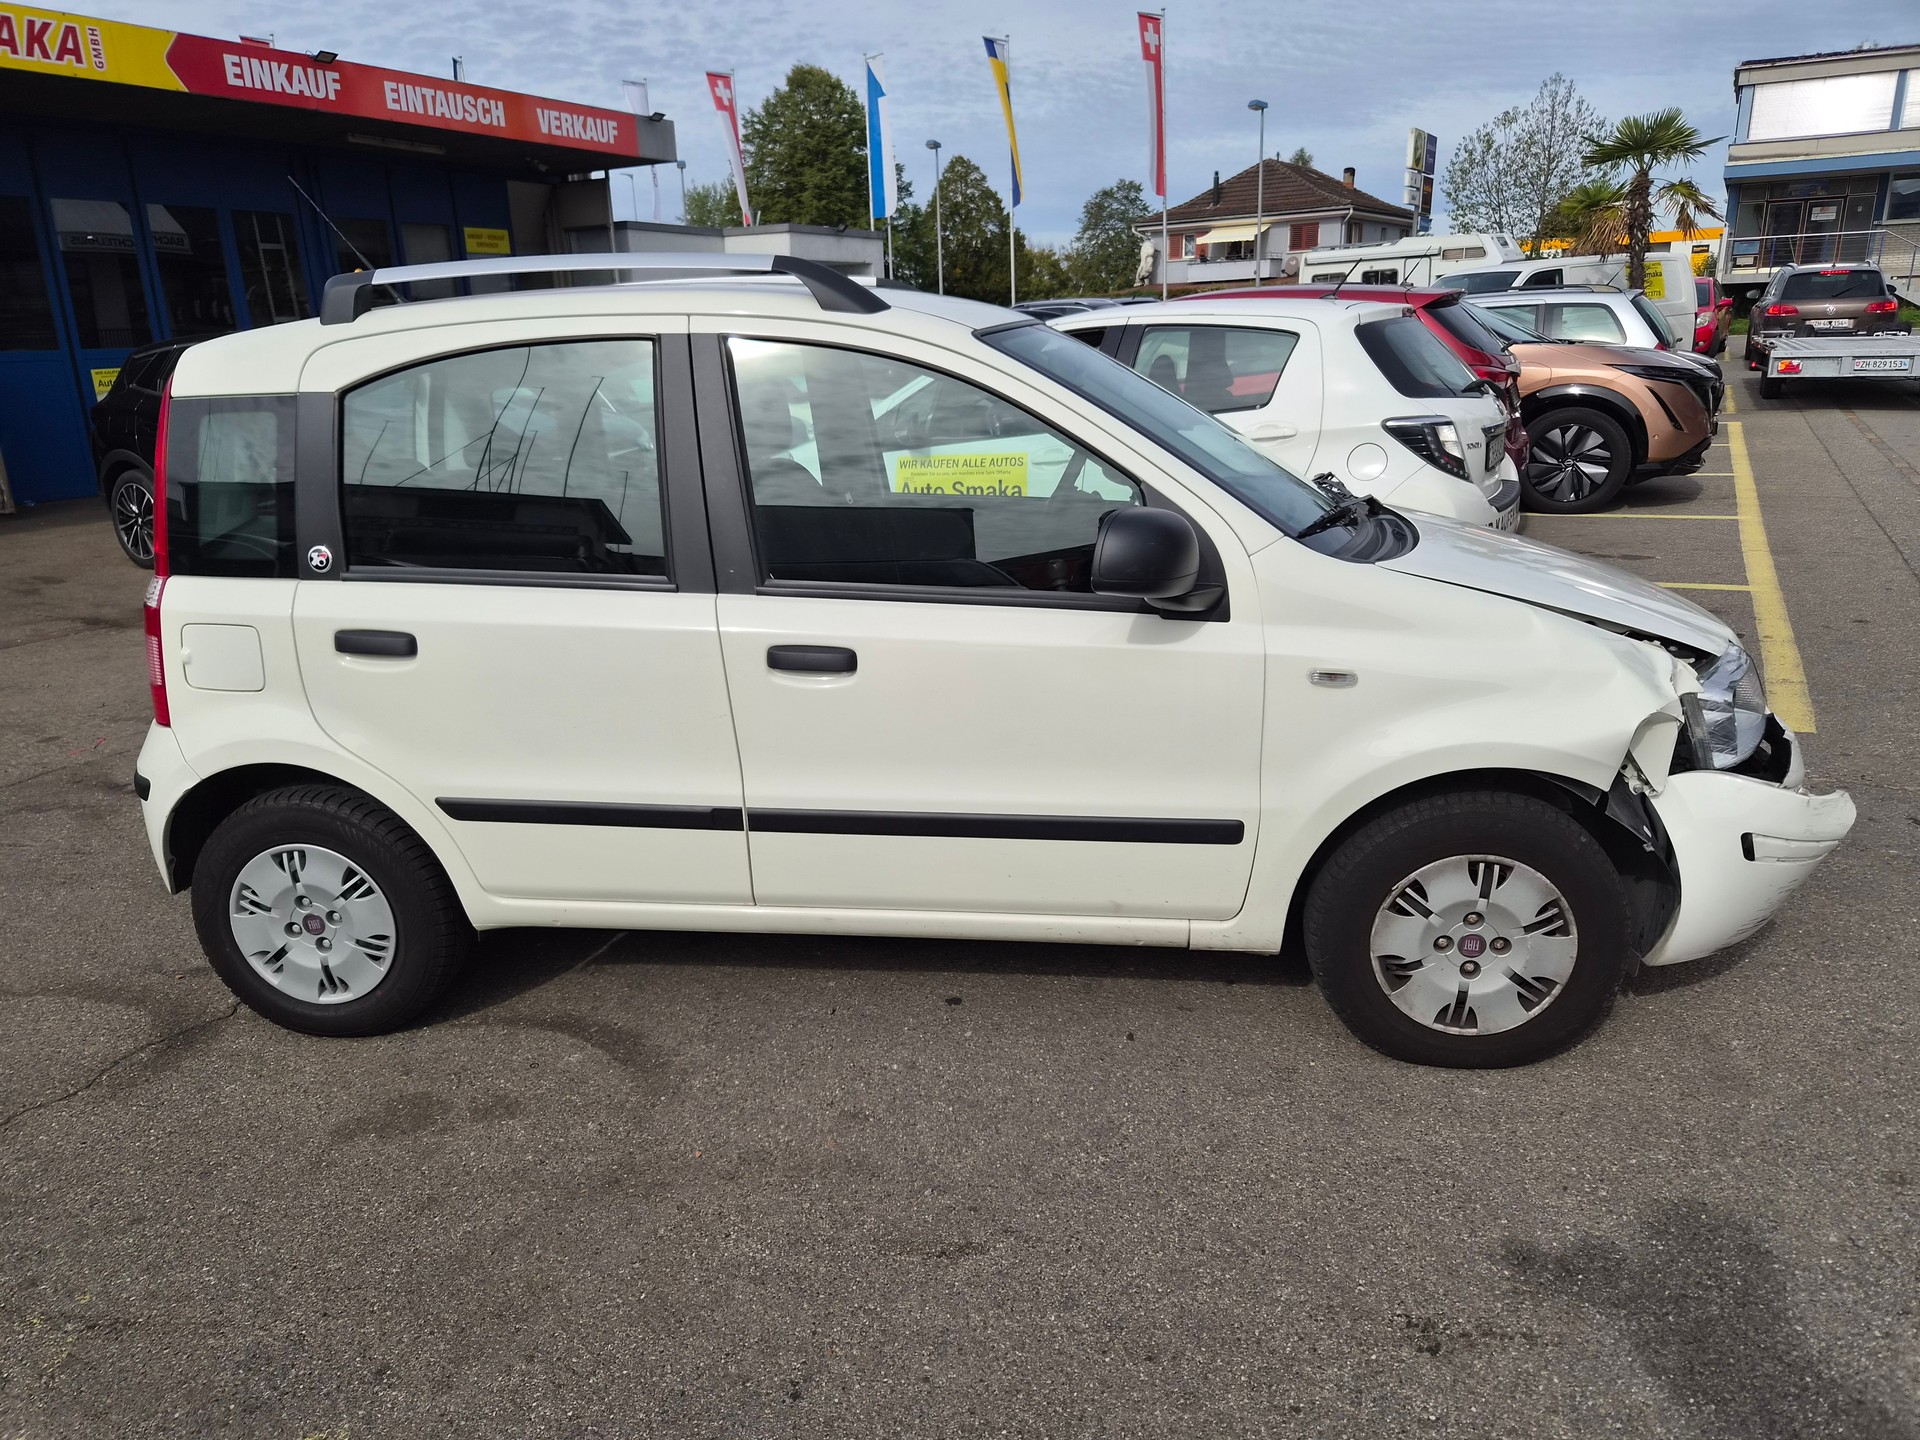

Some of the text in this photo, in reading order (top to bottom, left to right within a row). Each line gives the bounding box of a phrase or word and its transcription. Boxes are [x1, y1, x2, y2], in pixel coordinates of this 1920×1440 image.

[0, 13, 105, 69] AKA GMBH
[222, 53, 618, 144] EINKAUF EINTAUSCH VERKAUF
[899, 456, 1024, 469] WIR KAUFEN ALLE AUTOS
[307, 919, 321, 930] FIAT
[1463, 939, 1480, 951] FIAT
